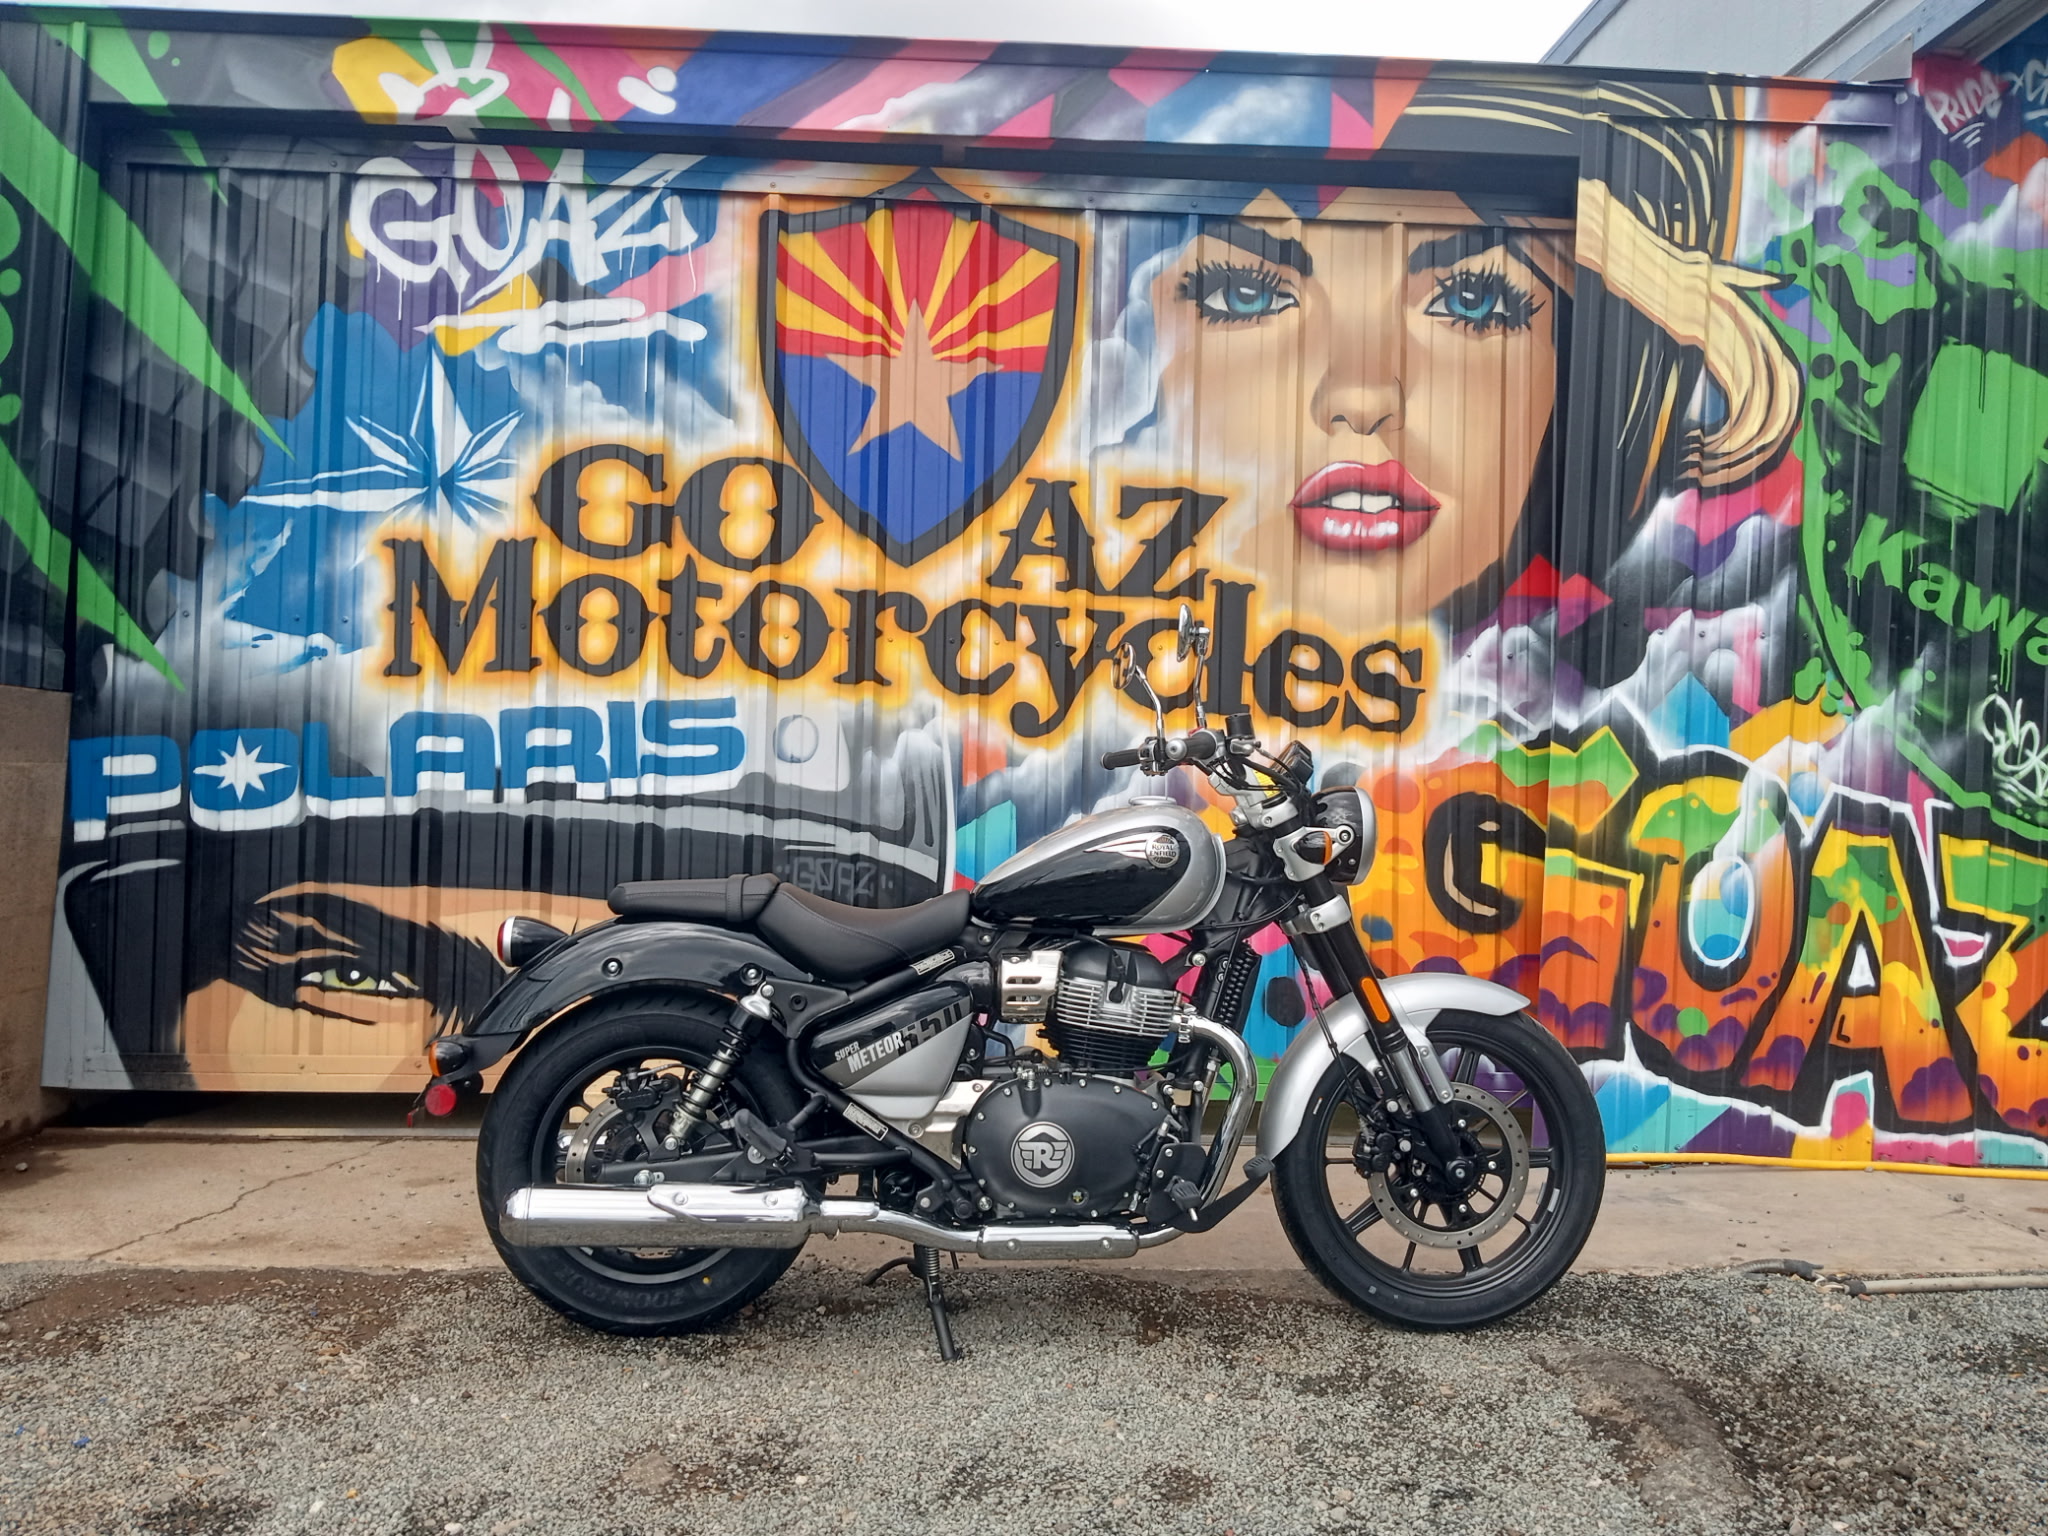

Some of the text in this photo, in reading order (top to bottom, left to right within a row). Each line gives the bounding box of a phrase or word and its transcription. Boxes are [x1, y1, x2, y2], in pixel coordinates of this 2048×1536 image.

[530, 443, 1228, 602] GO AZ
[382, 536, 1426, 738] Motorcycles
[70, 696, 747, 842] POLARIS
[834, 1041, 860, 1061] SUPER
[847, 1031, 904, 1073] METEOR
